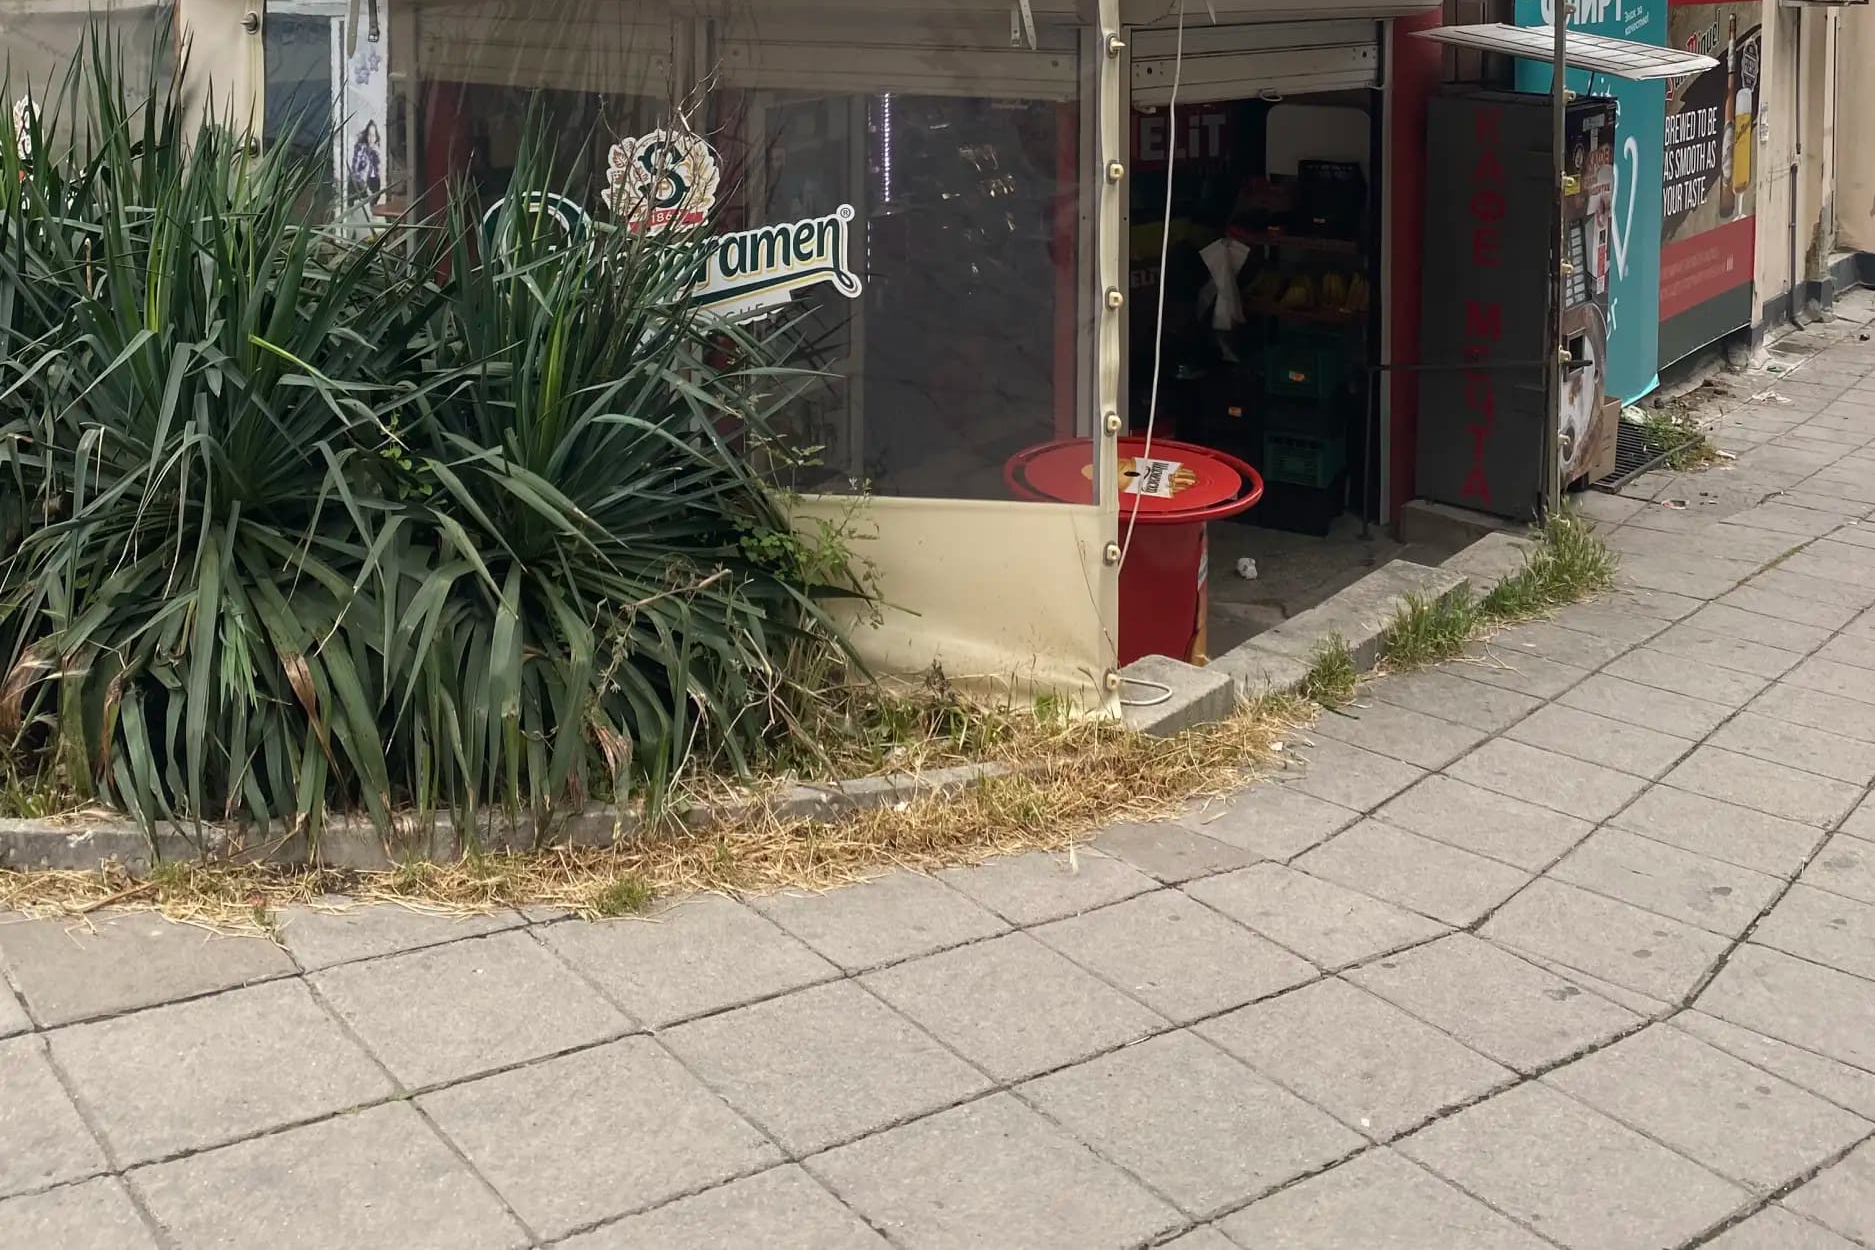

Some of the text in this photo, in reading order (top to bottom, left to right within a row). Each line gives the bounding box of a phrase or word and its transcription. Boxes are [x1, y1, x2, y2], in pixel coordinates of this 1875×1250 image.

[1664, 111, 1696, 146] BREWED
[1697, 109, 1707, 138] TO
[1708, 106, 1718, 135] BE
[1663, 140, 1717, 182] AS SMOOTH AS
[1469, 107, 1507, 268] КАФЕ
[1662, 176, 1708, 217] YOUR TASTE.
[1460, 299, 1504, 508] МЕЧТА
